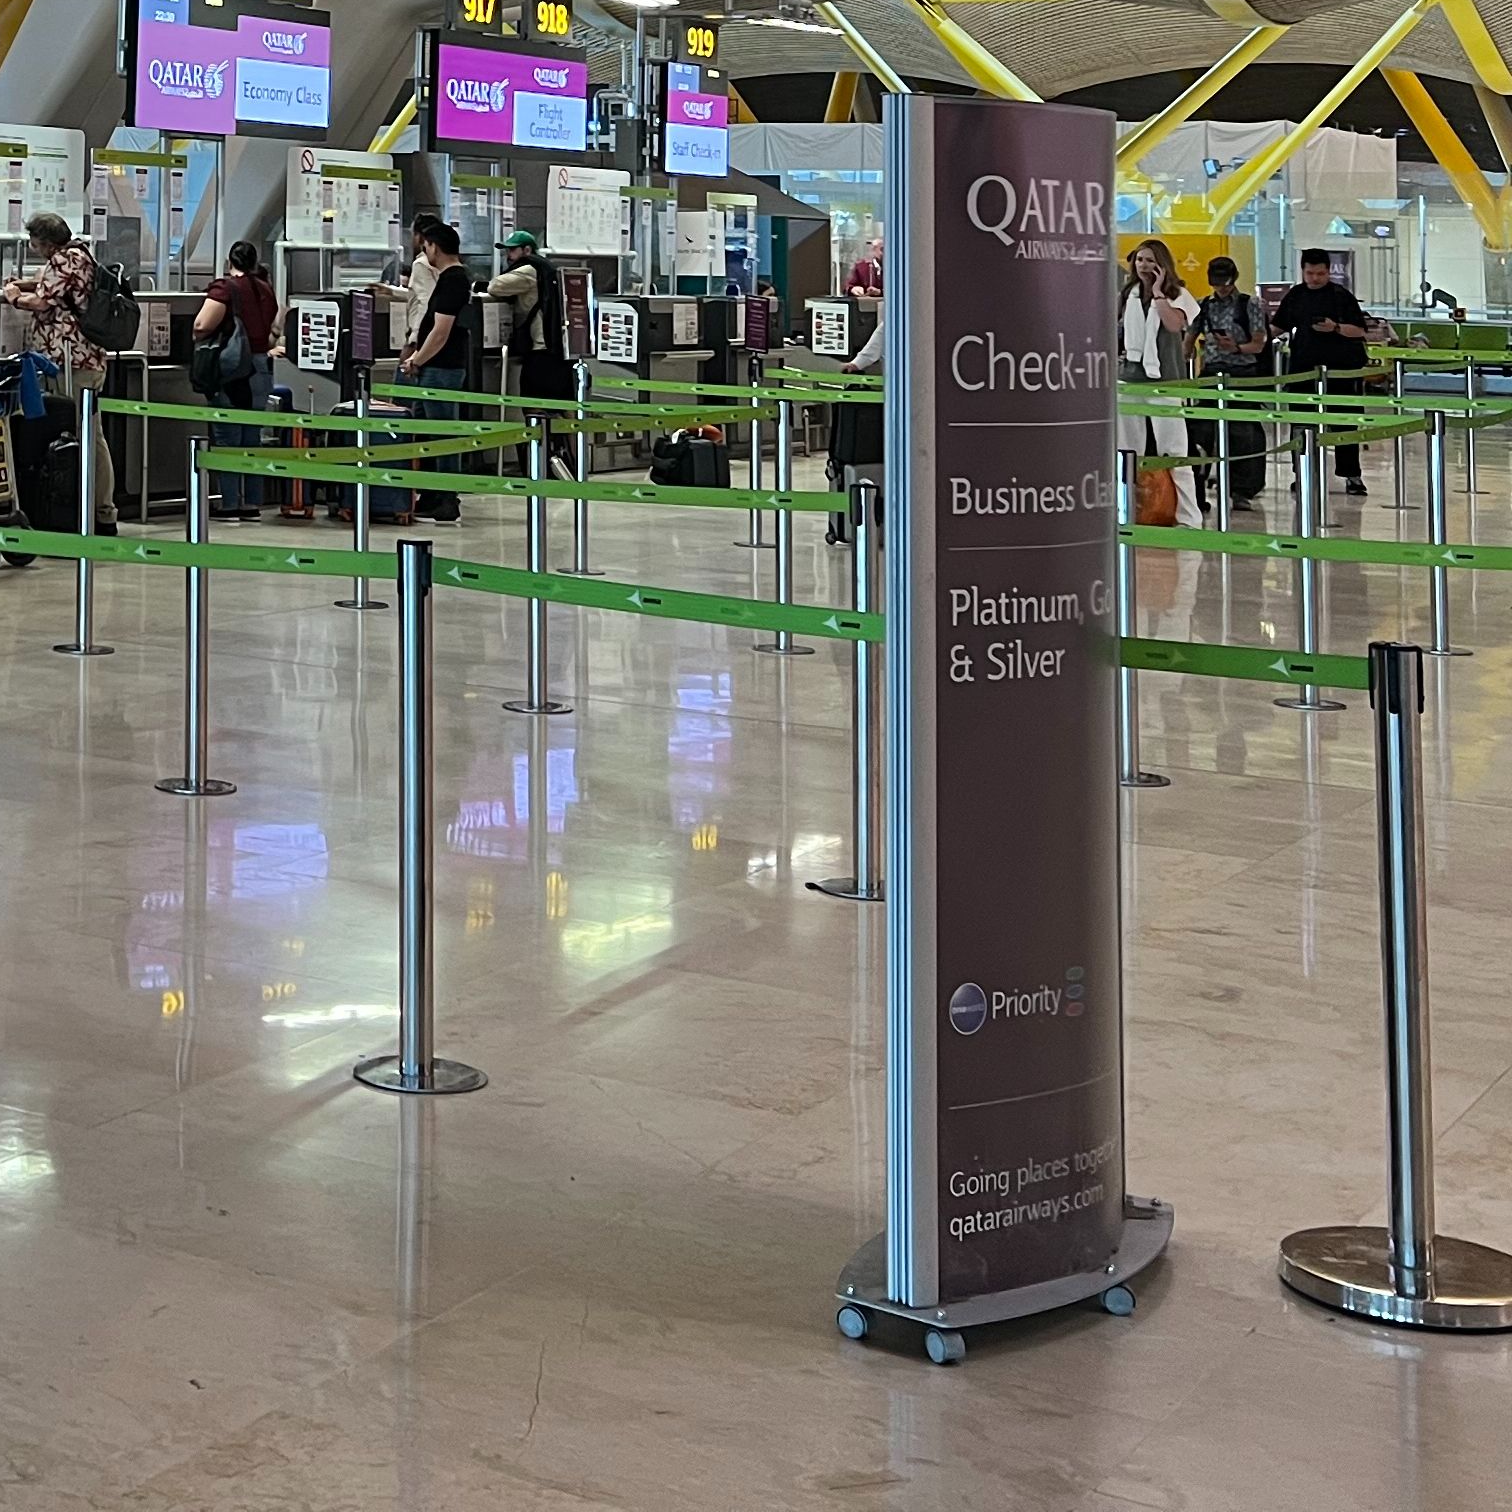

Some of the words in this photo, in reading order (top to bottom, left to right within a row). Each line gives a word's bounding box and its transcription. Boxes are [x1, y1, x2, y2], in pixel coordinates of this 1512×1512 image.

[537, 1, 568, 35] 918
[262, 31, 293, 50] QATAR
[688, 27, 714, 58] 919
[149, 59, 203, 90] QATAR
[243, 81, 293, 106] Economy
[296, 83, 322, 106] Class
[446, 78, 489, 106] QATAR
[529, 122, 571, 140] Controller
[539, 104, 563, 124] Flight
[967, 175, 1107, 246] QATAR
[1014, 239, 1070, 260] AIRWAYS
[950, 332, 1109, 392] Check-in
[950, 477, 1075, 515] Business
[950, 586, 1085, 627] Platinum,
[949, 644, 975, 683] &
[987, 639, 1066, 681] Silver
[992, 985, 1062, 1020] Priority
[949, 1168, 1010, 1198] Going
[1017, 1157, 1069, 1193] places
[949, 1184, 1104, 1241] qatarairways.com
